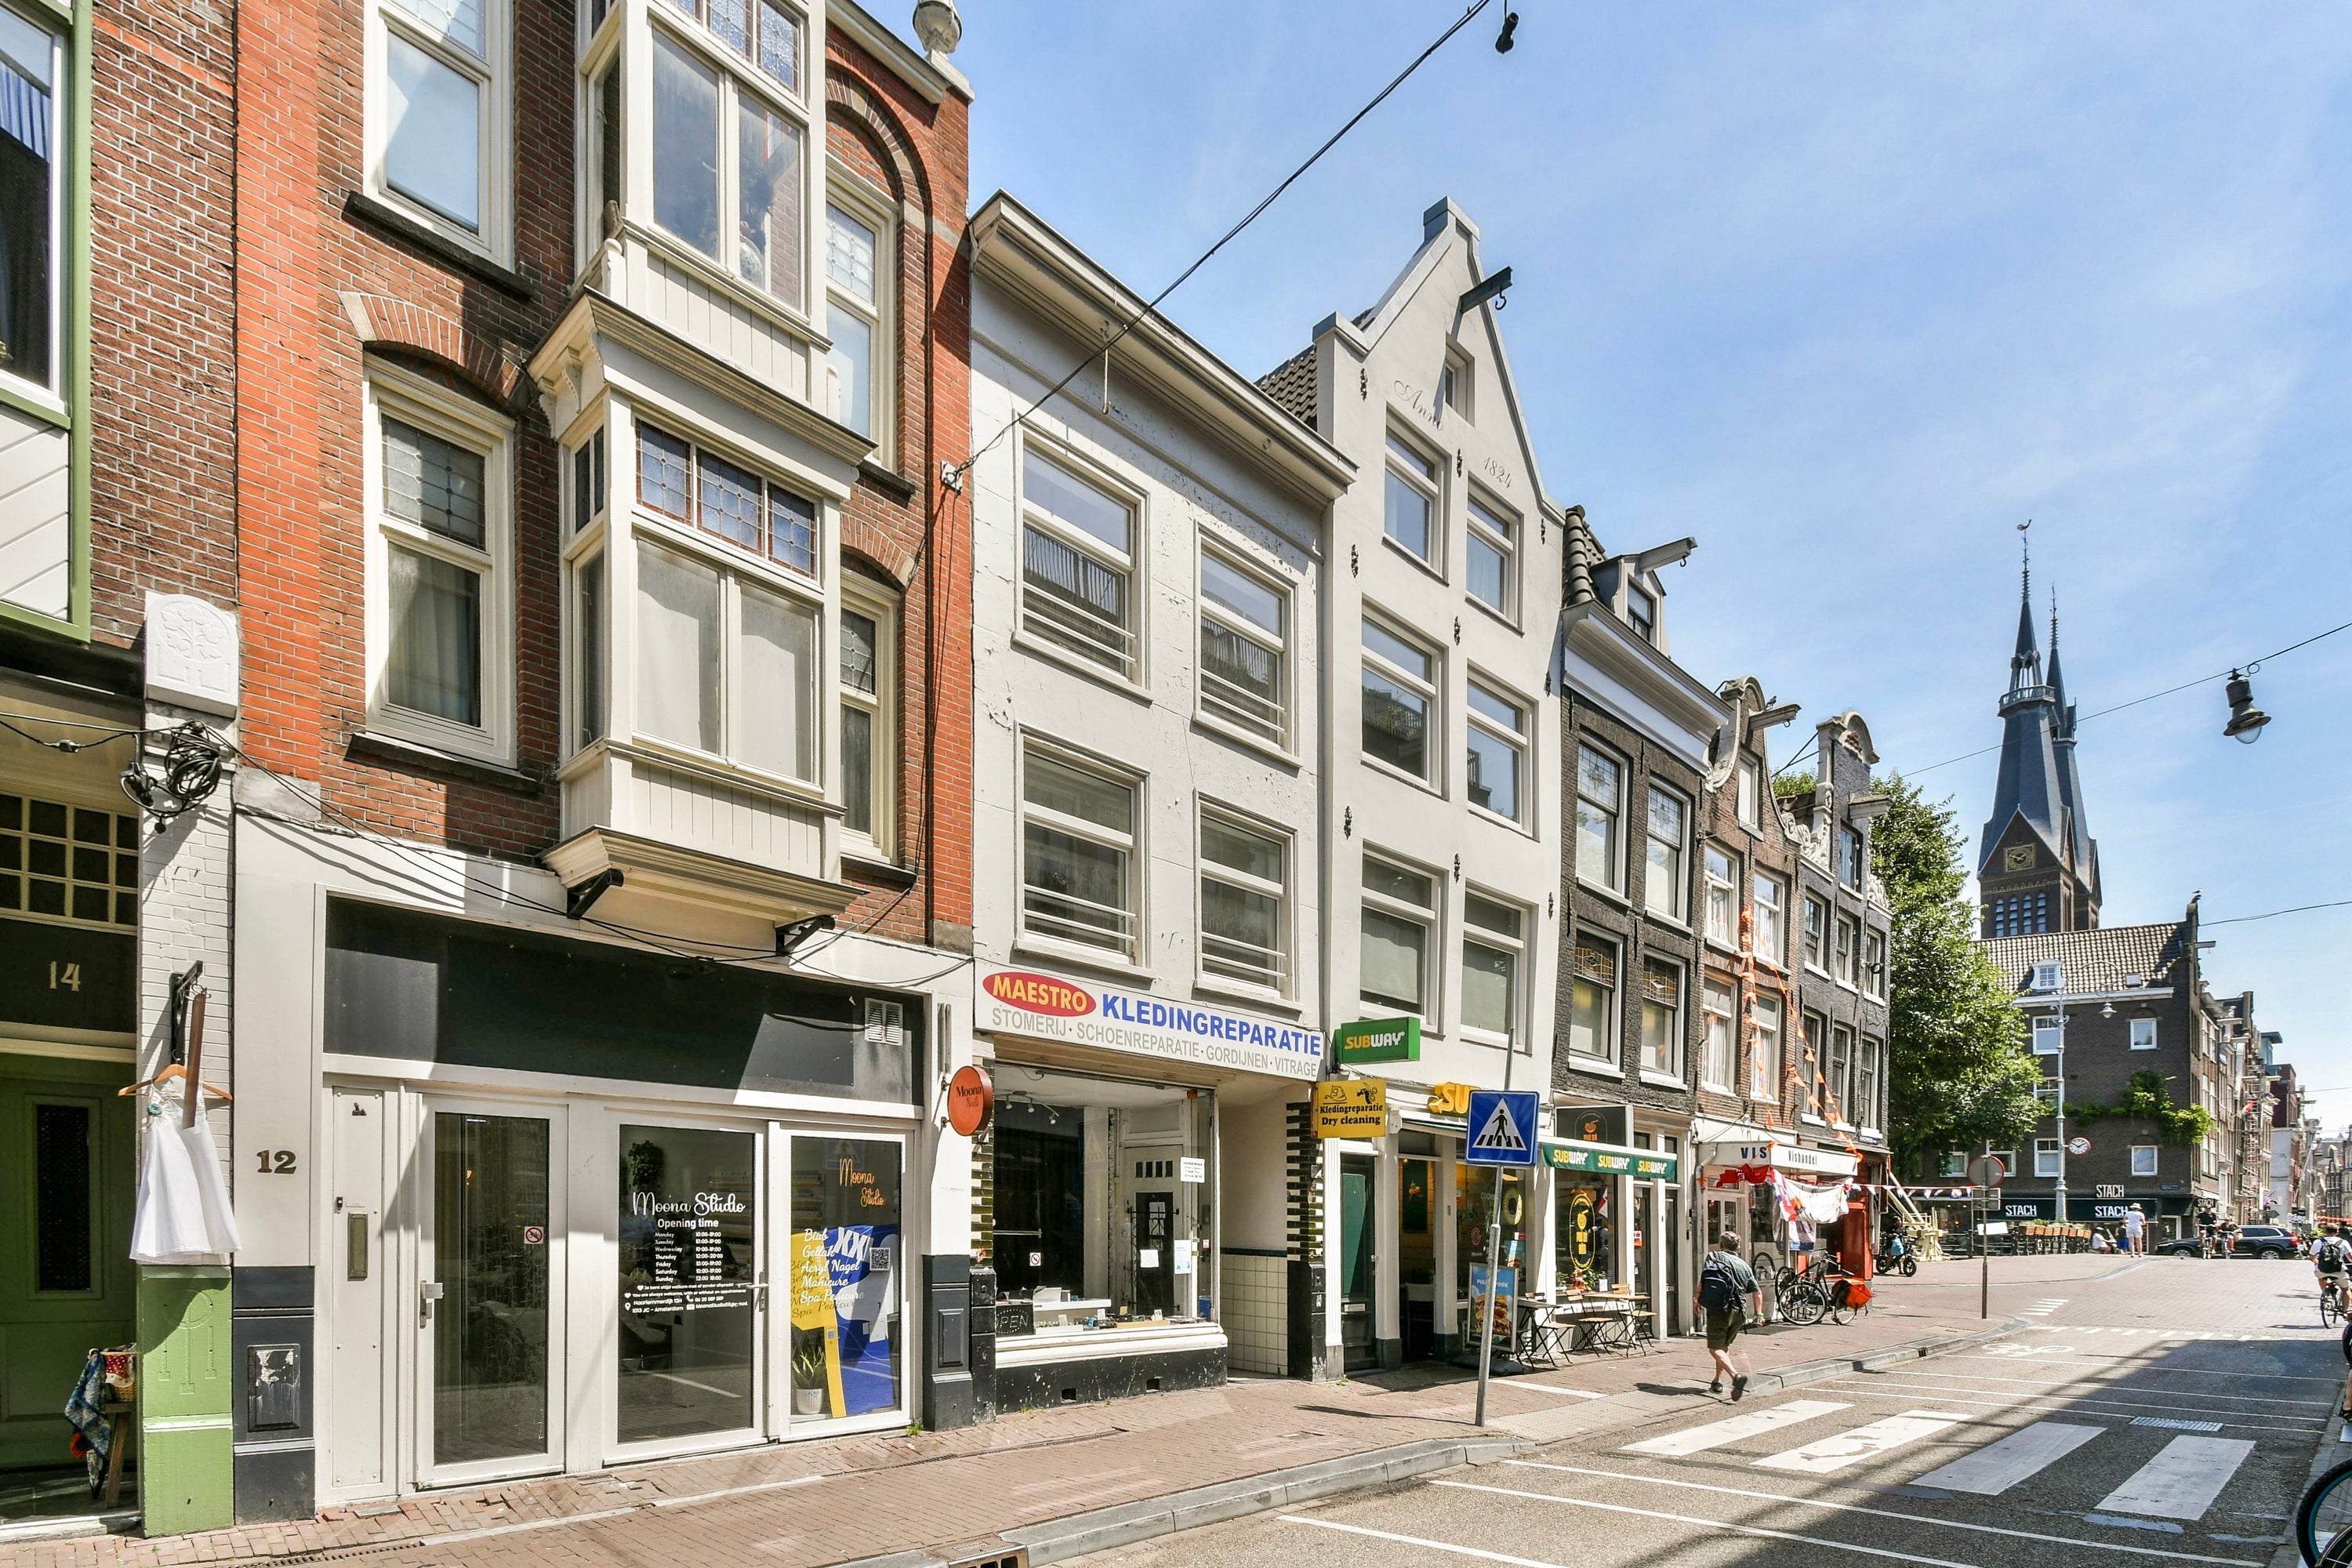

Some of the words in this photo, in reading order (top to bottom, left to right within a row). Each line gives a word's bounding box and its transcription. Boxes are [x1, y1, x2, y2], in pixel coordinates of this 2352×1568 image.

[1394, 380, 1443, 430] Anno
[1483, 456, 1512, 488] 1824
[49, 960, 81, 991] 14
[993, 975, 1087, 1012] MAESTRO
[1102, 993, 1321, 1056] KLEDINGREPARATIE
[992, 1007, 1066, 1036] STOMERIJ
[1077, 1022, 1200, 1058] SCHOENREPARATIE
[1206, 1045, 1268, 1069] GORDIJNEN
[1275, 1057, 1317, 1077] VITRAGE
[1344, 1031, 1406, 1051] SUBWAY
[956, 1086, 982, 1098] Moona
[1319, 1102, 1384, 1114] Kledingreparatie
[1322, 1116, 1338, 1127] Dry
[1341, 1115, 1381, 1126] cleaning
[1553, 1149, 1588, 1166] SUBWAY
[1740, 1147, 1767, 1159] VIS
[1788, 1150, 1817, 1166] Vishandel
[256, 1149, 296, 1174] 12
[1598, 1154, 1630, 1170] SUBWAY
[1637, 1160, 1668, 1174] SUBWAY
[839, 1158, 875, 1187] Moona
[860, 1187, 885, 1207] Studio
[2096, 1185, 2125, 1198] STACH
[633, 1192, 691, 1216] Moona
[694, 1192, 746, 1216] Studio
[2005, 1204, 2037, 1216] STACH
[2095, 1206, 2129, 1217] STACH
[657, 1218, 696, 1229] Opening
[698, 1218, 719, 1228] time
[804, 1228, 829, 1242] Biab
[802, 1245, 835, 1258] Gellak
[800, 1260, 829, 1276] Acryl
[831, 1259, 860, 1274] Nagel
[800, 1275, 848, 1288] Manicure
[800, 1290, 821, 1306] Spa
[823, 1289, 866, 1301] Pedicure
[996, 1315, 1028, 1328] PEN
